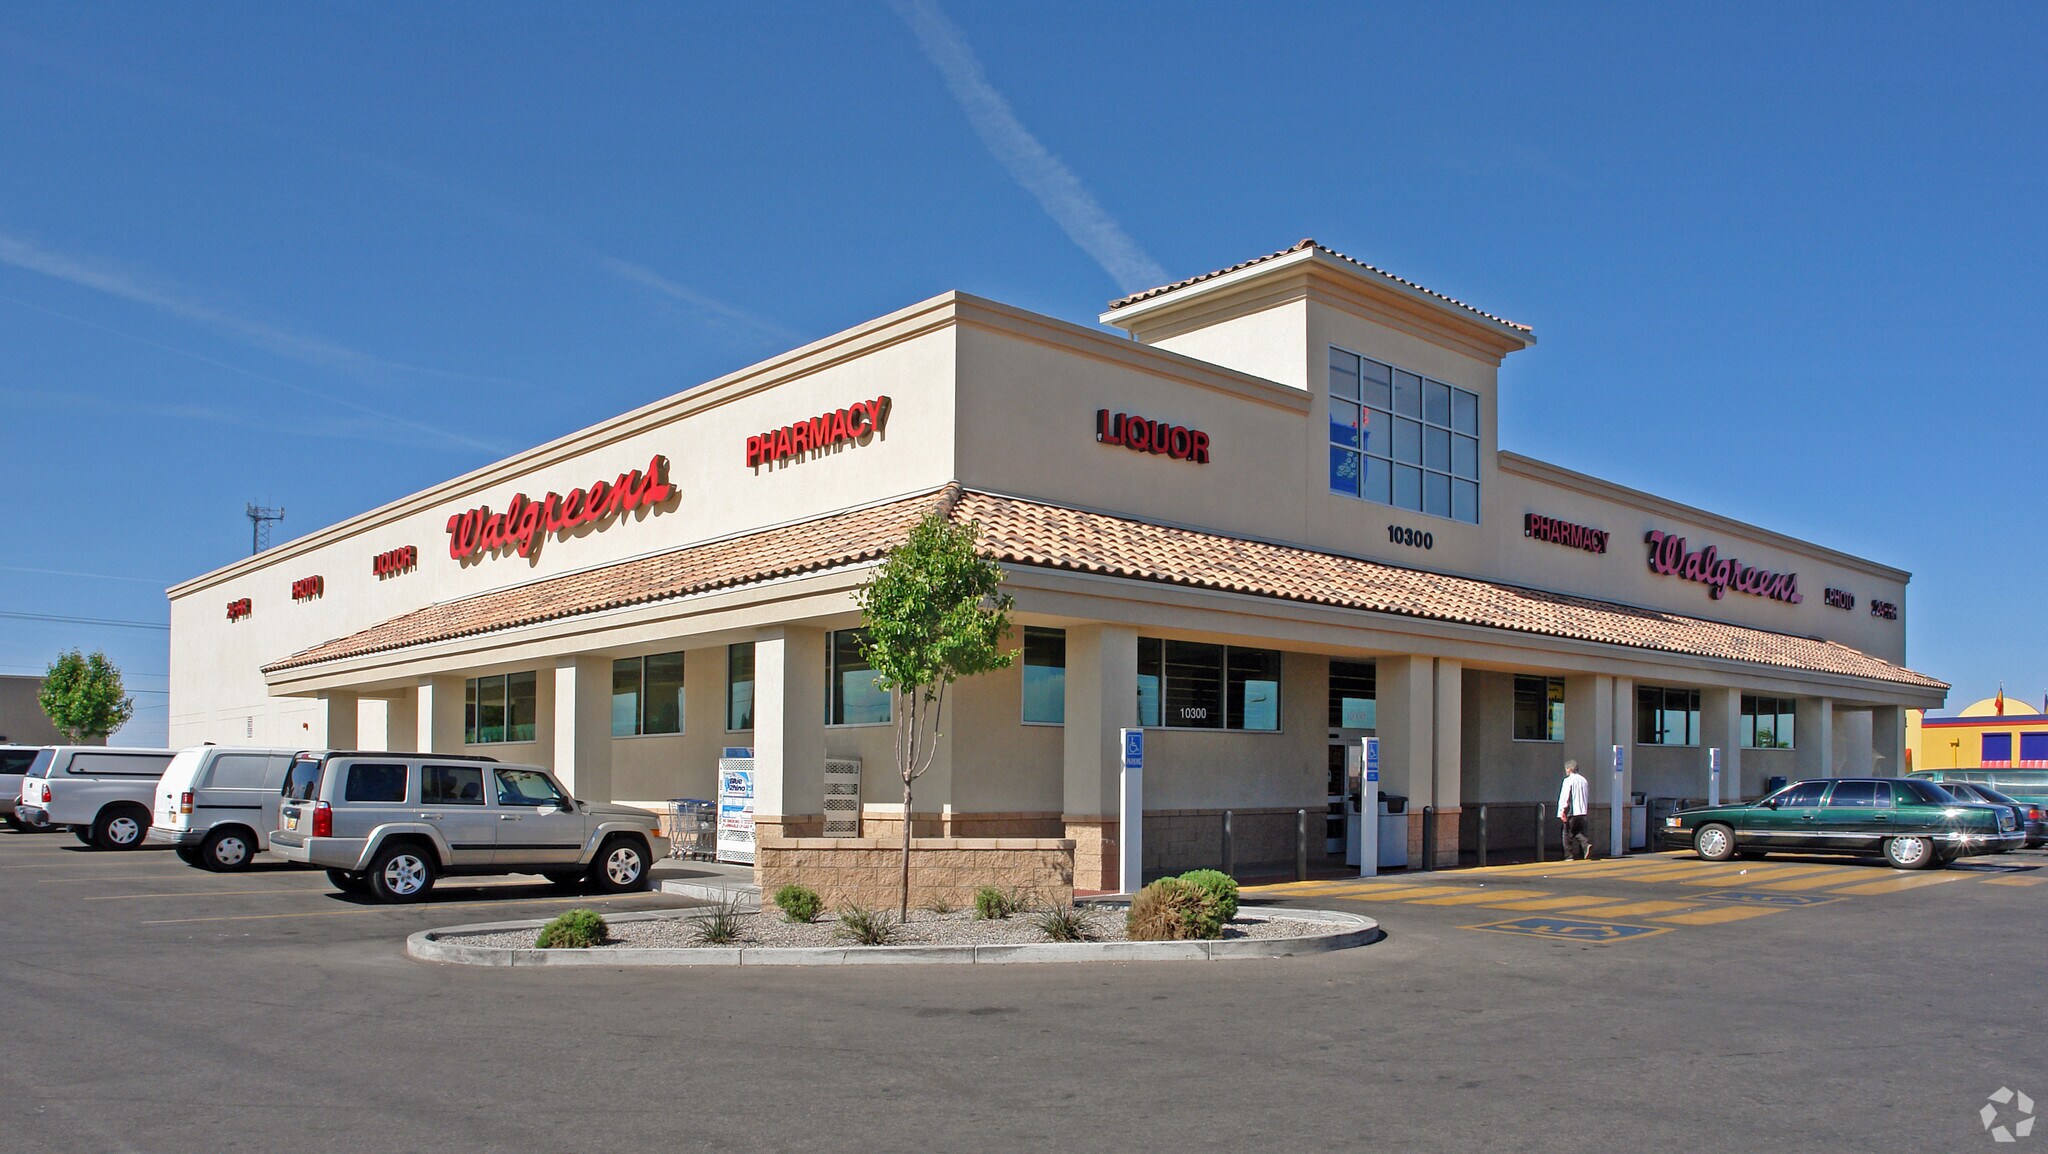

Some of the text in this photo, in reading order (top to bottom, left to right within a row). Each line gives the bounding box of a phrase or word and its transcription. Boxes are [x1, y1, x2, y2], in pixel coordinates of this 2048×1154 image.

[747, 395, 890, 468] PHARMACY
[1097, 409, 1210, 463] LIQUOR
[447, 454, 676, 560] Walgreens
[1388, 525, 1433, 550] 10300
[1525, 513, 1610, 553] PHARMACY
[373, 545, 417, 577] LIQUOR
[1645, 530, 1803, 604] Walgreens
[292, 575, 324, 600] PHOTO
[1825, 588, 1855, 610] PHOTO
[1180, 707, 1207, 719] 10300
